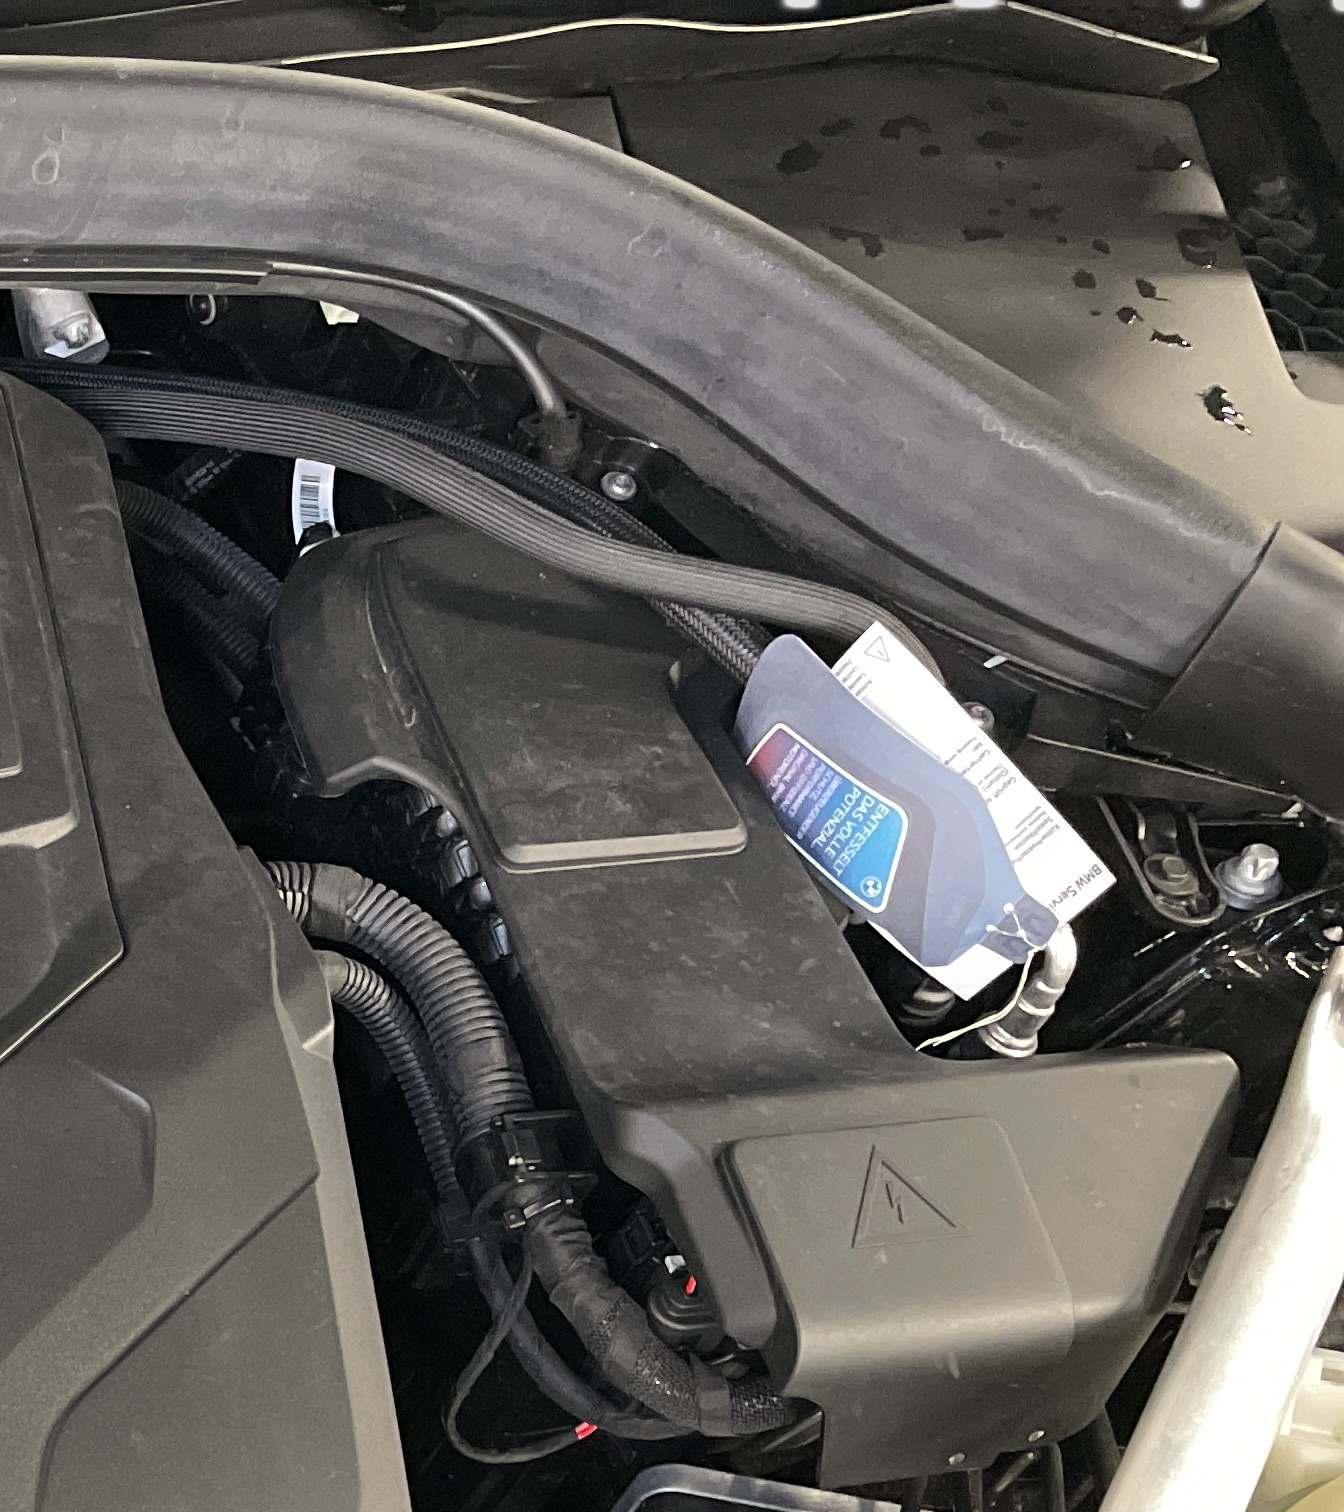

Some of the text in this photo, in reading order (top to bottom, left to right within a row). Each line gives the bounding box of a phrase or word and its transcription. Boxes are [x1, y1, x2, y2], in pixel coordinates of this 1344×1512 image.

[822, 793, 876, 859] DAS VOLLE
[829, 801, 890, 877] ENTFESSELT
[1047, 863, 1103, 911] BMW Servi
